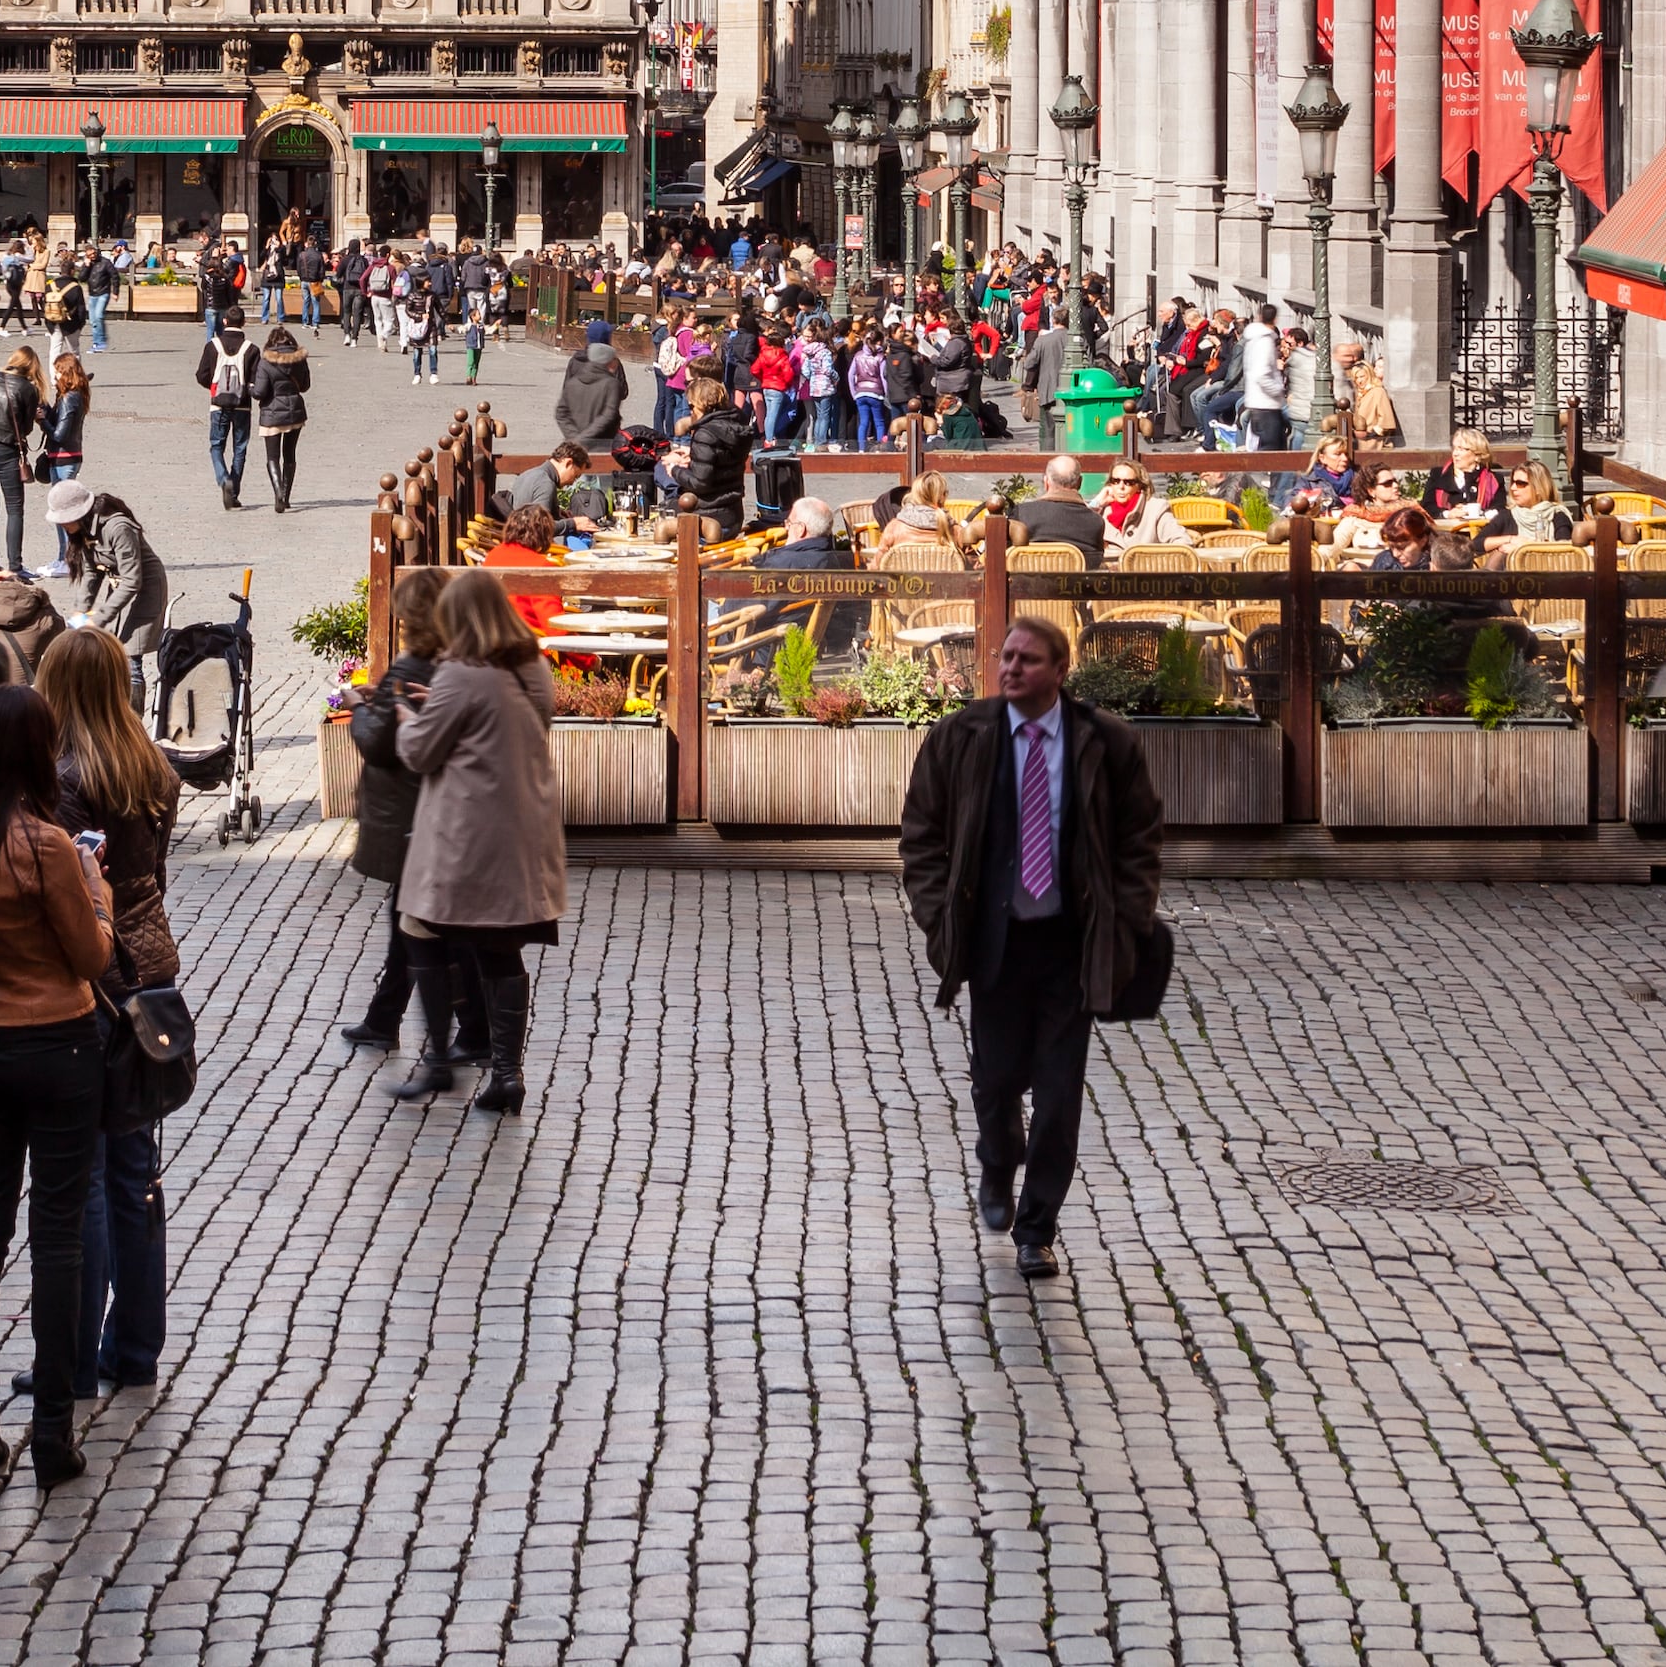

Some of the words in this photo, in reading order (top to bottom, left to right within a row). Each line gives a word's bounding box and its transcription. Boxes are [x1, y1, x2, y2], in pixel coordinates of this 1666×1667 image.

[682, 34, 694, 91] HOTEL
[1494, 94, 1511, 102] van
[750, 574, 777, 594] La
[787, 574, 876, 597] Chaloupe
[887, 574, 935, 595] d'Or
[1056, 575, 1083, 595] La
[1093, 575, 1181, 597] Chaloupe
[1193, 575, 1240, 595] d'Or
[1364, 575, 1388, 595] La
[1399, 575, 1486, 596] Chaloupe
[1499, 576, 1545, 595] d'Or
